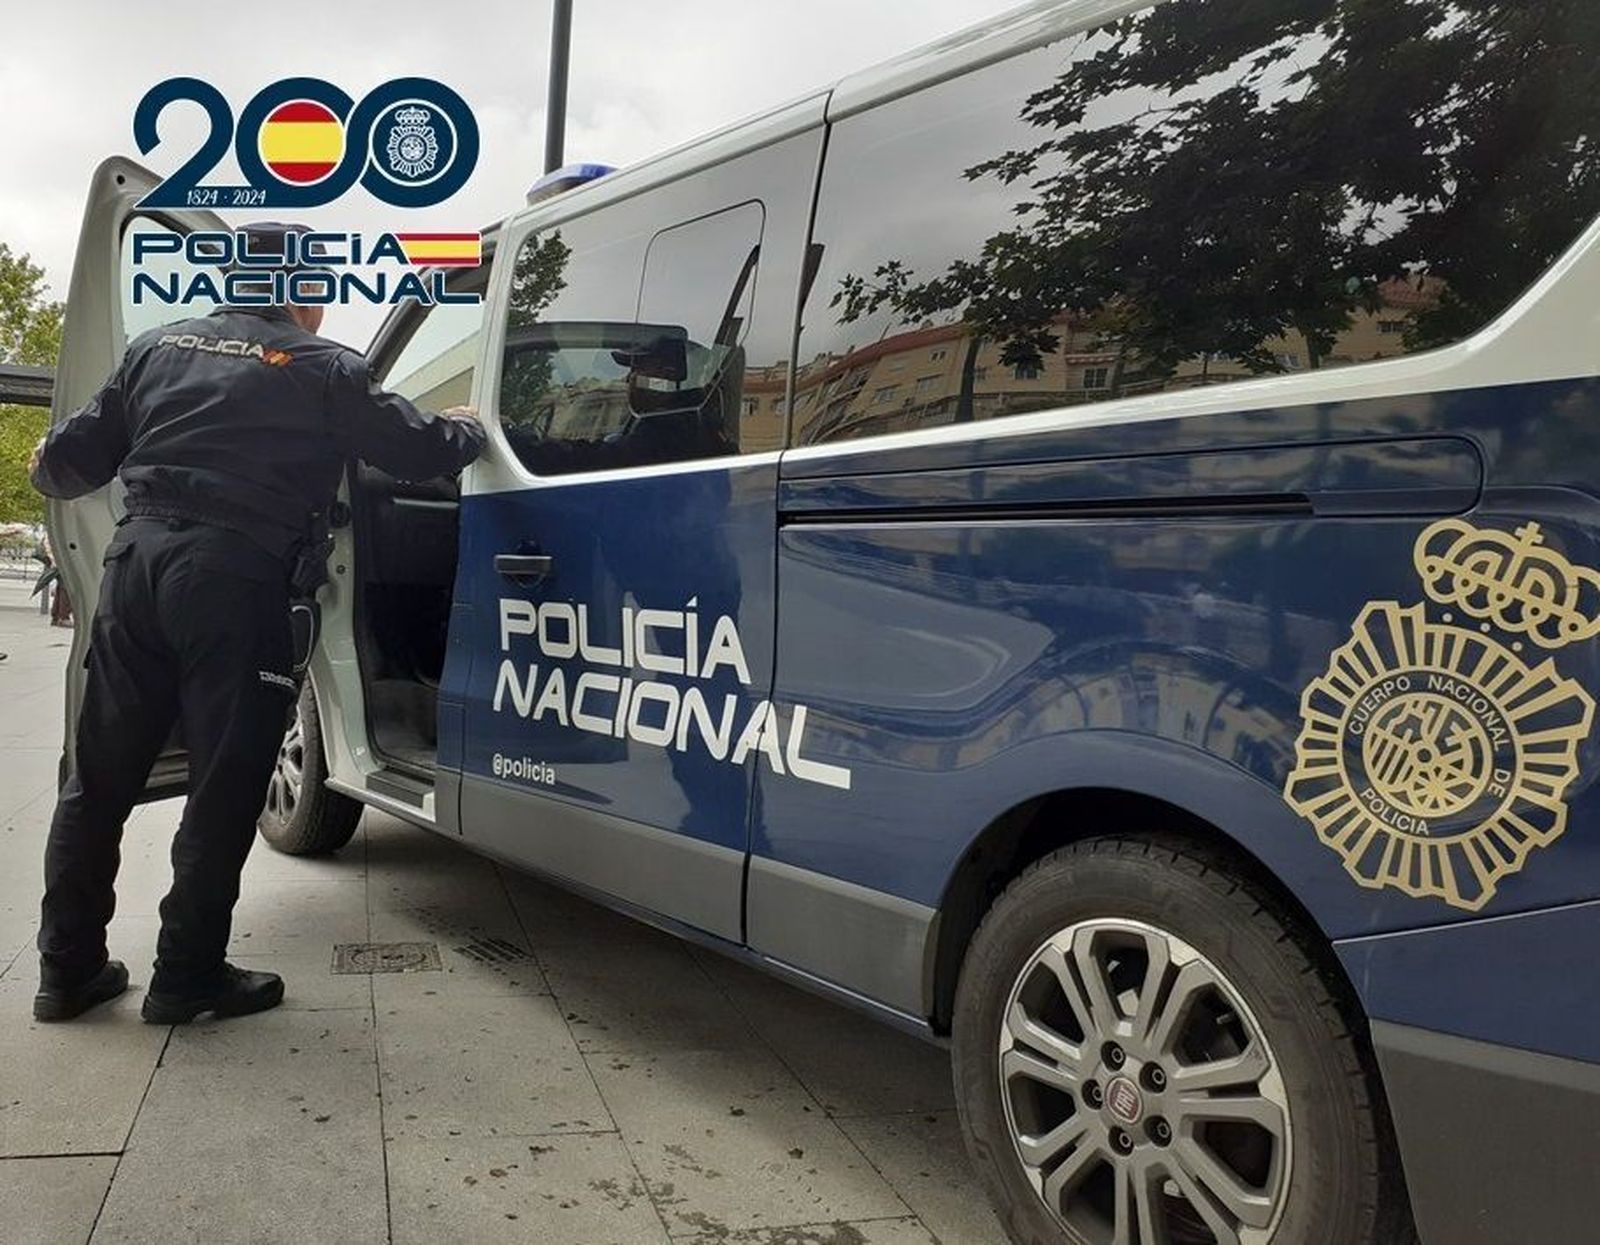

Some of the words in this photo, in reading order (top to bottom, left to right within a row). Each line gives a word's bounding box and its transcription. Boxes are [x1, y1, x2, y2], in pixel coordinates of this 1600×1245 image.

[157, 334, 264, 358] POLICIA
[500, 596, 751, 684] POLICÍA
[493, 659, 850, 789] NACIONAL
[1349, 676, 1411, 735] CUERPO
[1427, 675, 1511, 751] NACIONAL
[1488, 768, 1511, 798] DE
[492, 753, 556, 785] @policia
[1360, 788, 1430, 836] POLICIA
